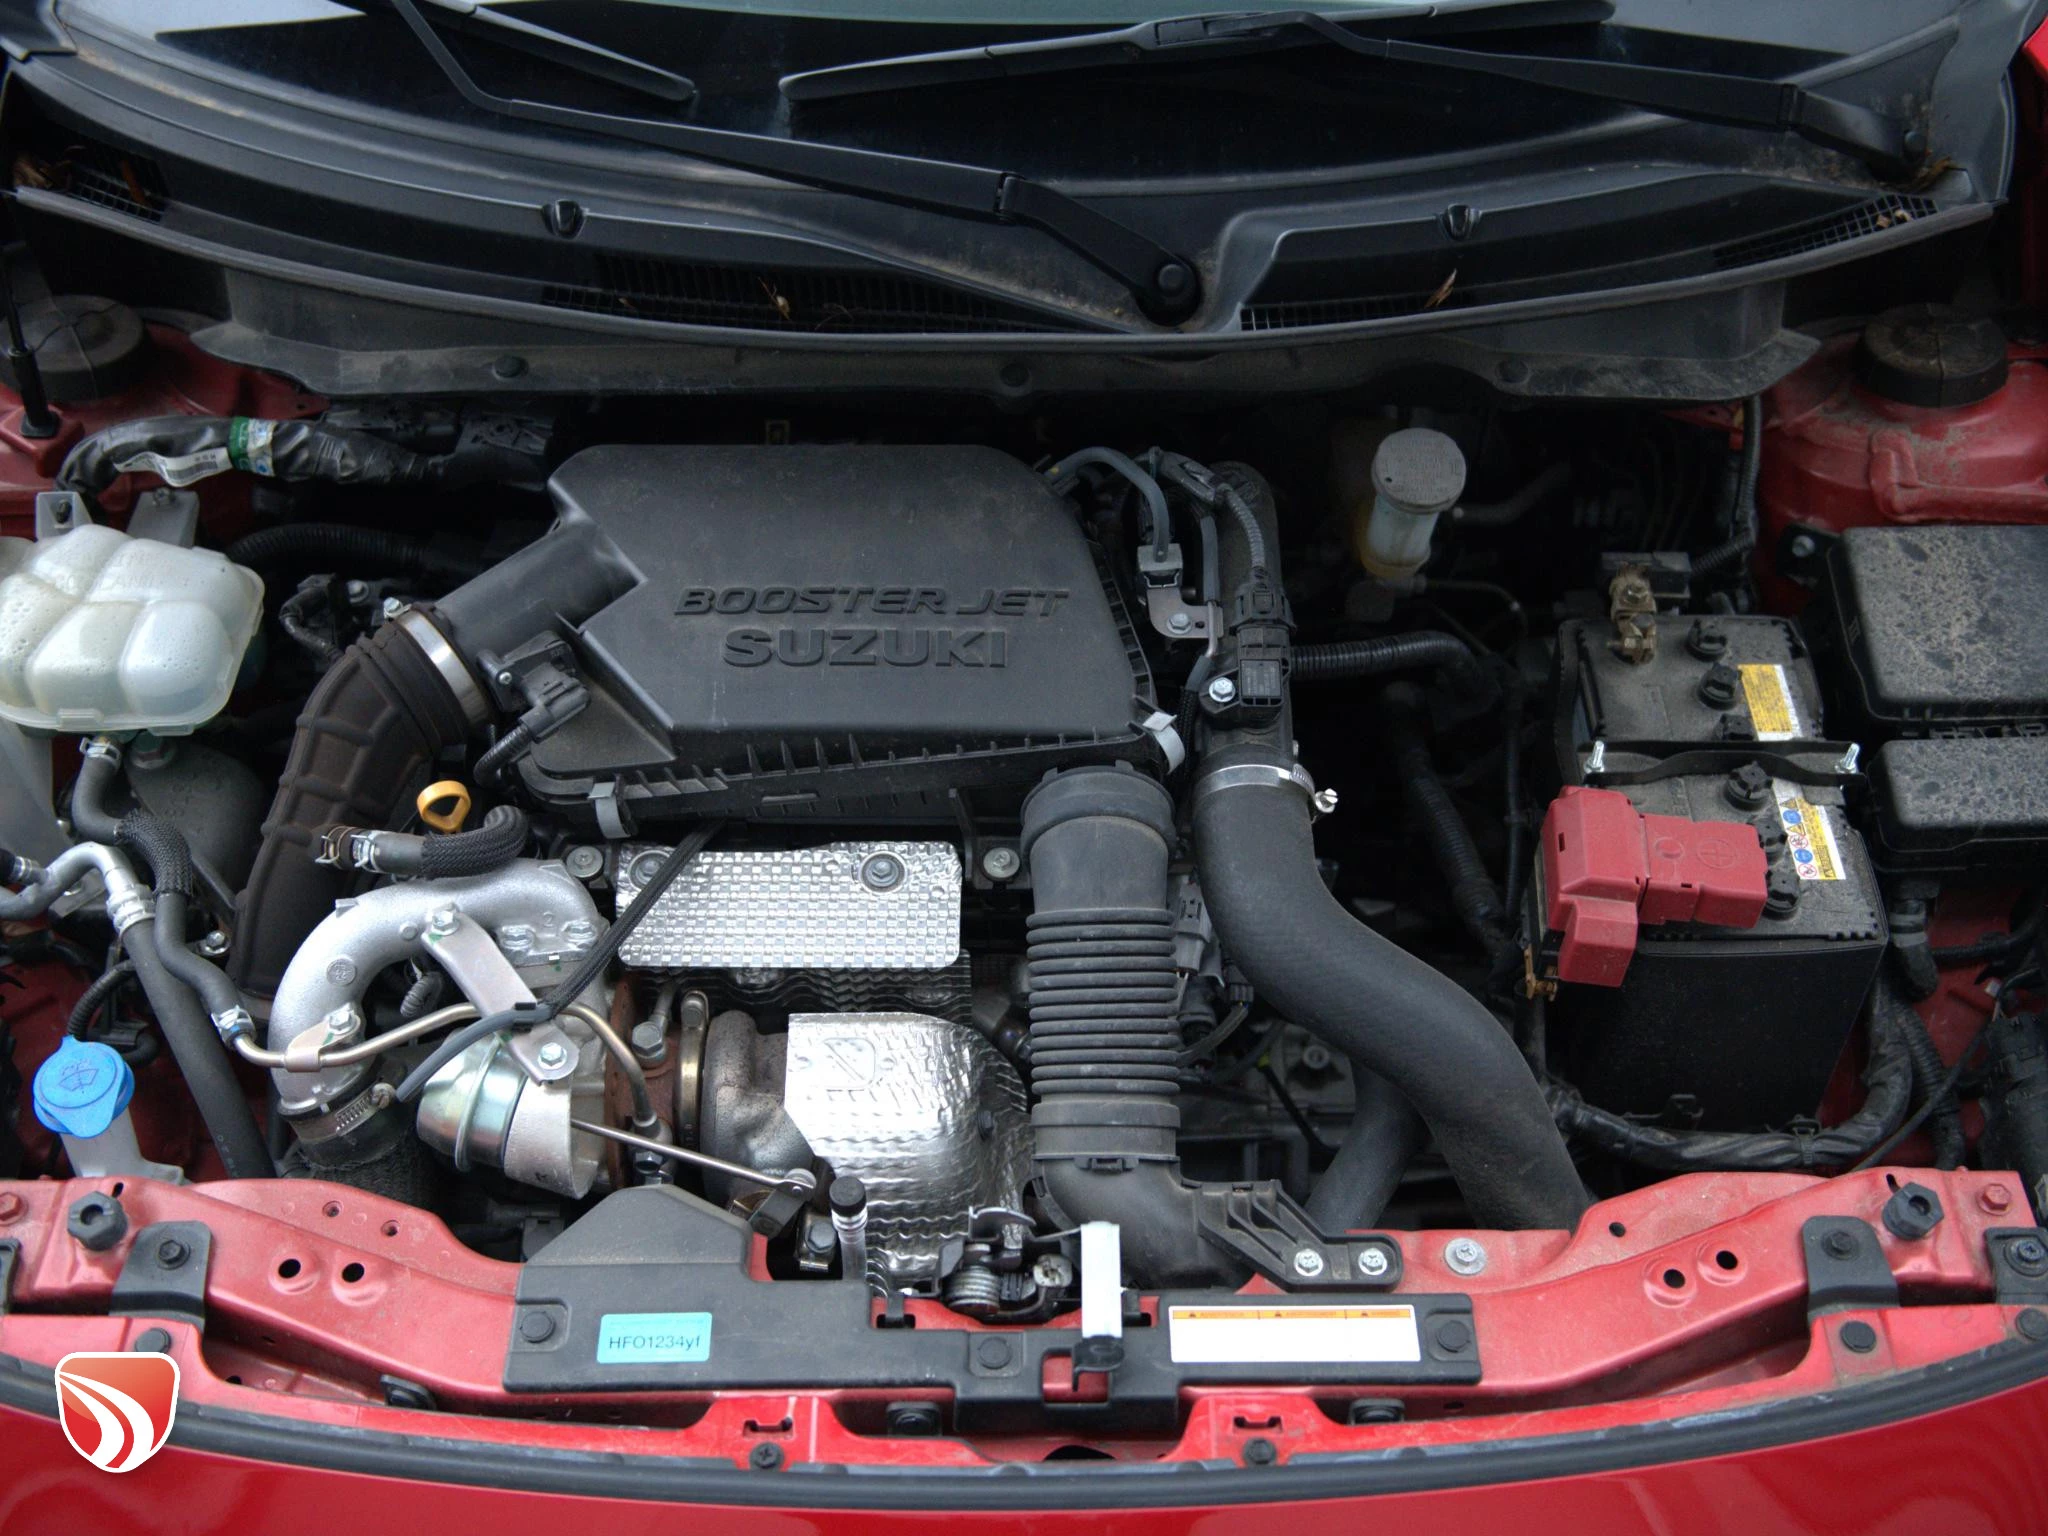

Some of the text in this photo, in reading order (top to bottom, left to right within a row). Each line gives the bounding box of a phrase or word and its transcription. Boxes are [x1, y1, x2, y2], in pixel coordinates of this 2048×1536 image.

[673, 586, 1070, 617] BOOSTER JET
[722, 628, 1007, 669] SUZUKI
[608, 1334, 701, 1352] HFO1234yf
